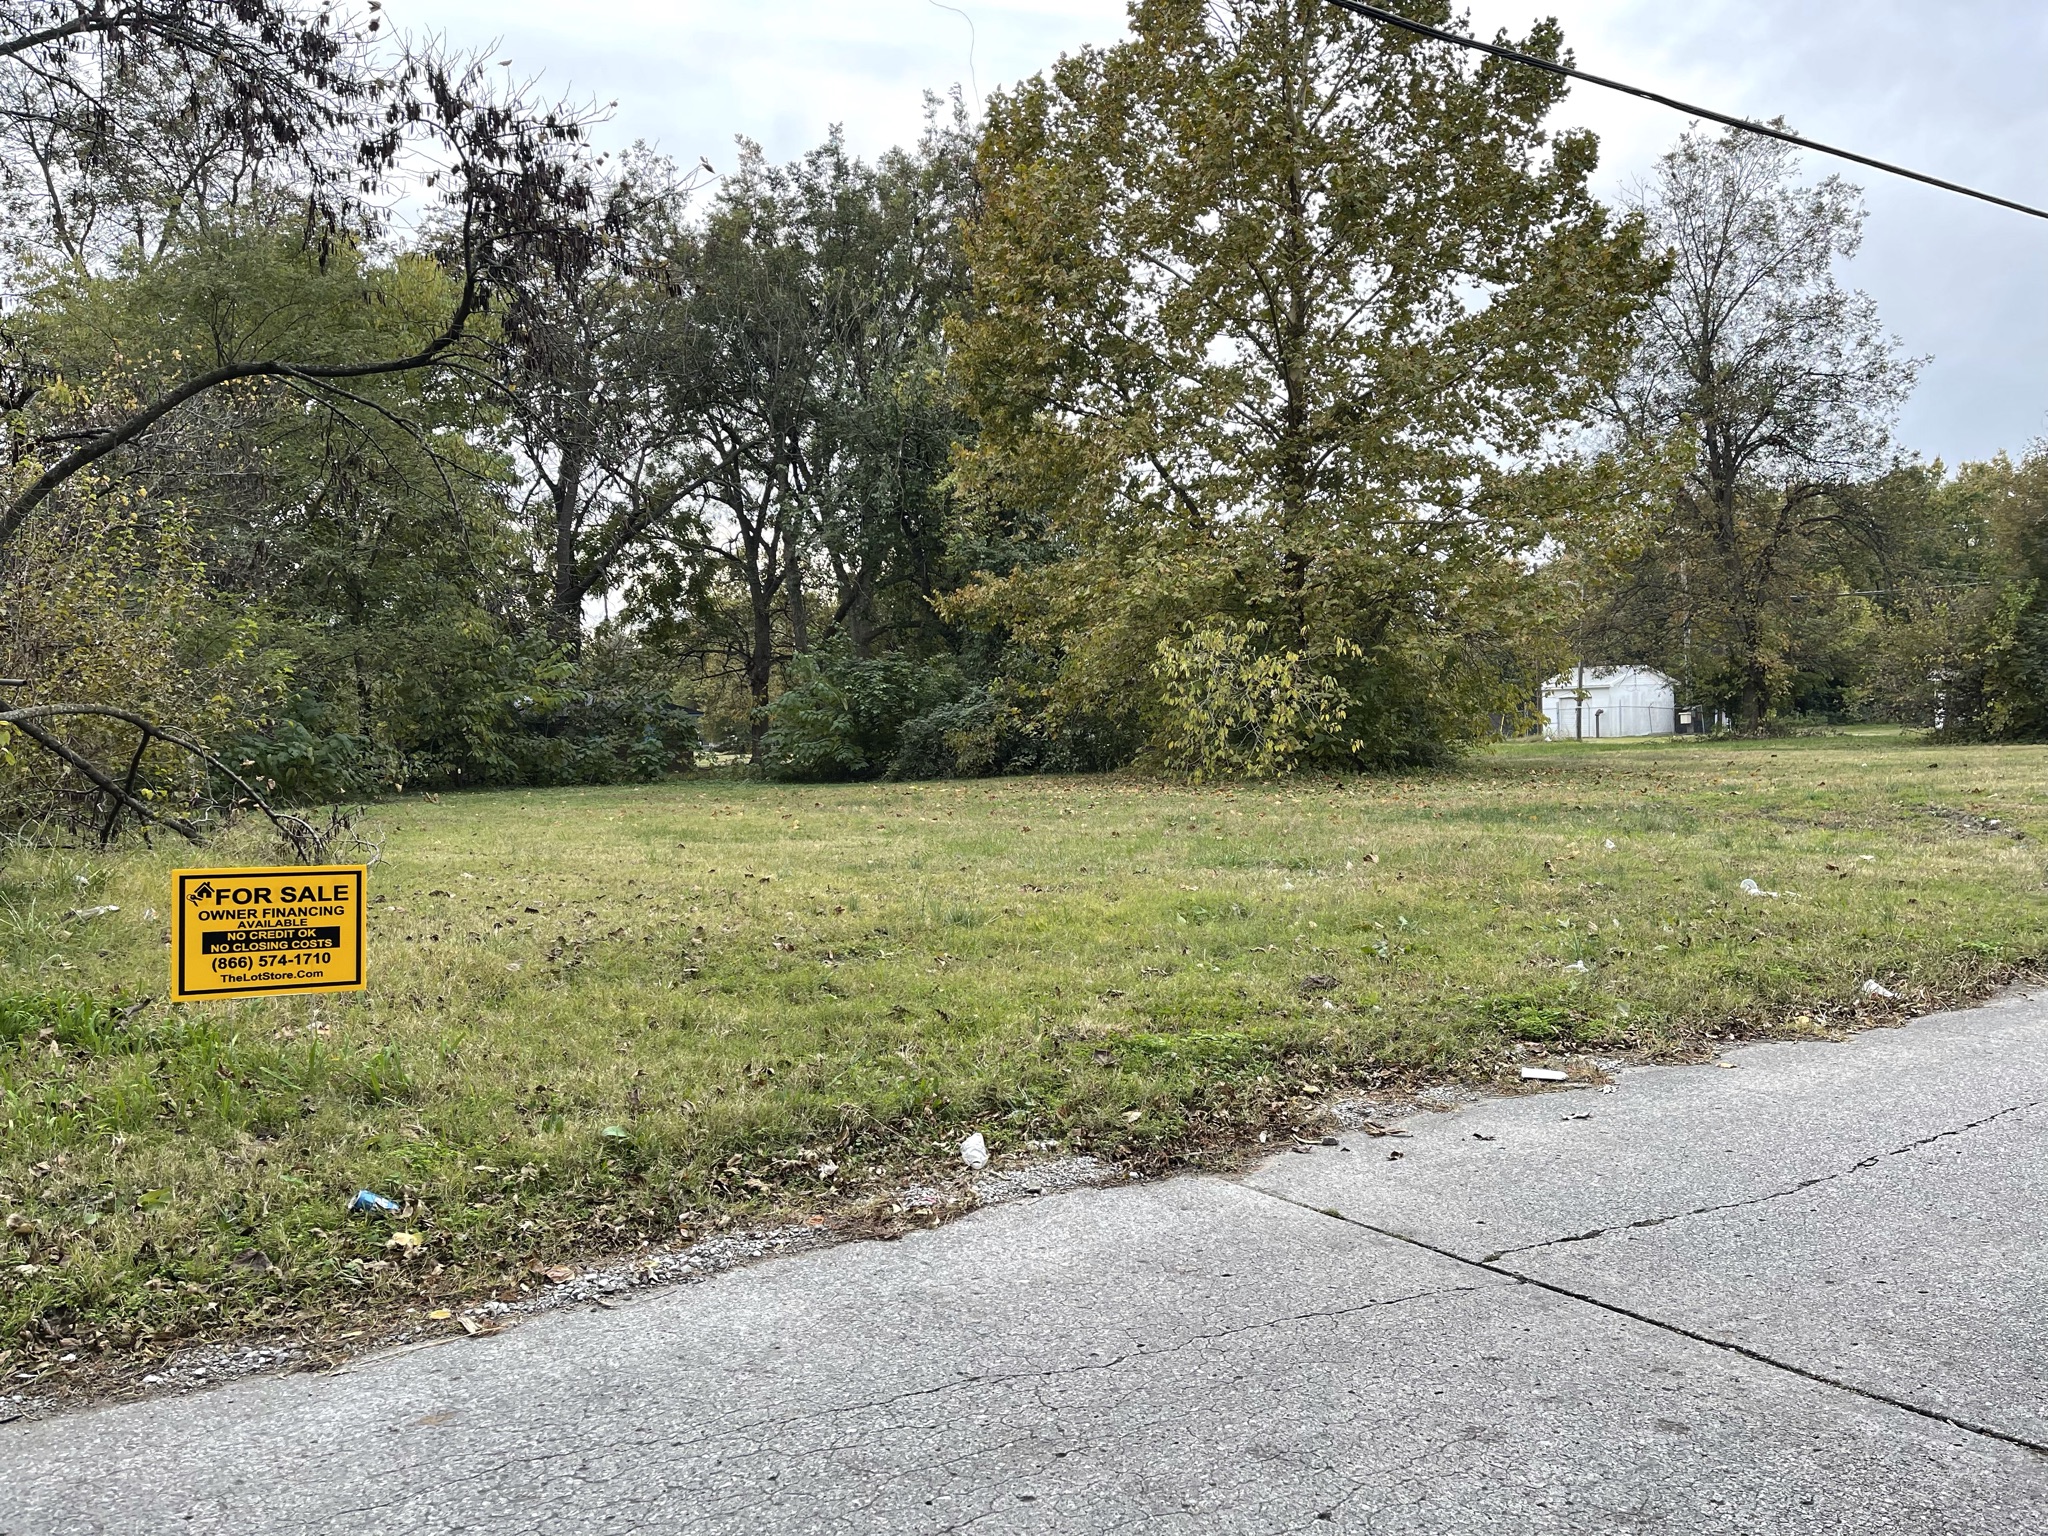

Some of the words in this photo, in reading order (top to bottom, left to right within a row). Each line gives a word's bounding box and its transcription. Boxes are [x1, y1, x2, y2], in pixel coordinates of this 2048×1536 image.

[216, 888, 272, 905] FOR
[280, 885, 348, 902] SALE
[198, 909, 257, 921] OWNER
[263, 906, 344, 918] FINANCING
[238, 919, 307, 928] AVAILABLE
[227, 932, 245, 940] NO
[249, 930, 295, 940] CREDIT
[298, 929, 316, 938] OK
[211, 944, 229, 953] NO
[233, 941, 288, 952] CLOSING
[292, 939, 332, 948] COSTS
[212, 956, 253, 972] (866)
[259, 952, 330, 967] 574-1710
[221, 970, 323, 982] TheLotStore.Com
